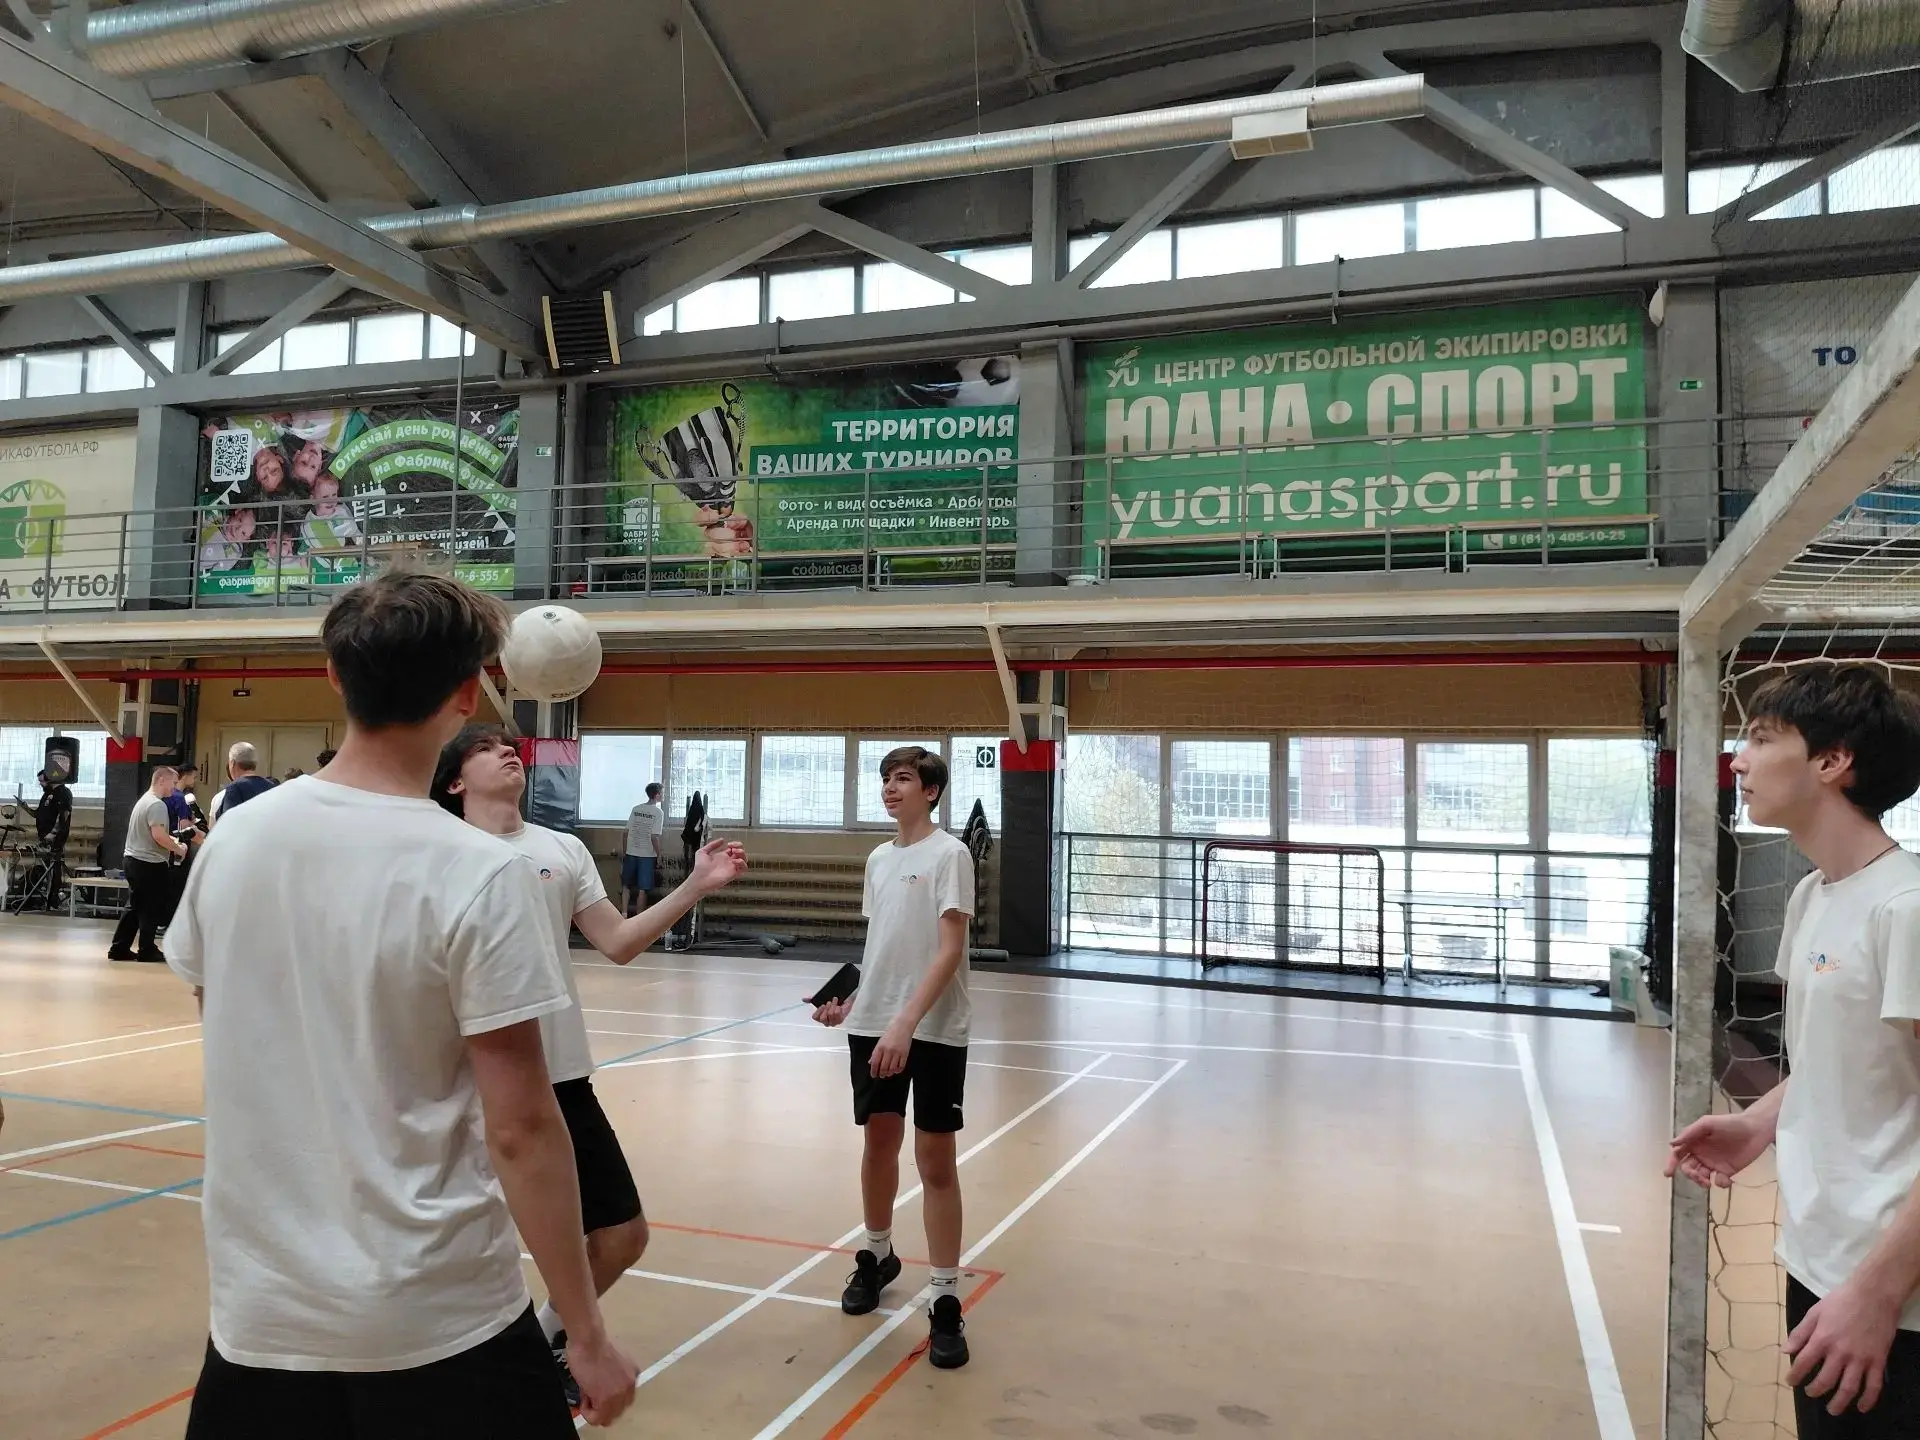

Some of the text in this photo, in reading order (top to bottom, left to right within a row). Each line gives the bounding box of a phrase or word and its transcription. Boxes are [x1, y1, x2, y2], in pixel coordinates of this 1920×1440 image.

[1155, 323, 1627, 388] ЦЕНТР ФУТБОЛЬНОЙ ЭКИПИРОВКИ
[1106, 357, 1628, 464] ЮАНА СПОРТ
[831, 414, 1014, 443] ТЕРРИТОРИЯ
[335, 426, 392, 471] Отмечай
[395, 424, 429, 438] день
[757, 447, 1013, 475] ВАШИХ ТУРНИРОВ
[374, 462, 391, 476] на
[778, 499, 819, 511] Фото-
[824, 500, 832, 510] и
[1111, 452, 1621, 540] yuanasport.ru
[787, 517, 838, 532] Аренда
[843, 516, 915, 532] площадки
[1509, 534, 1518, 545] 8
[1559, 530, 1626, 542] 405-10-25
